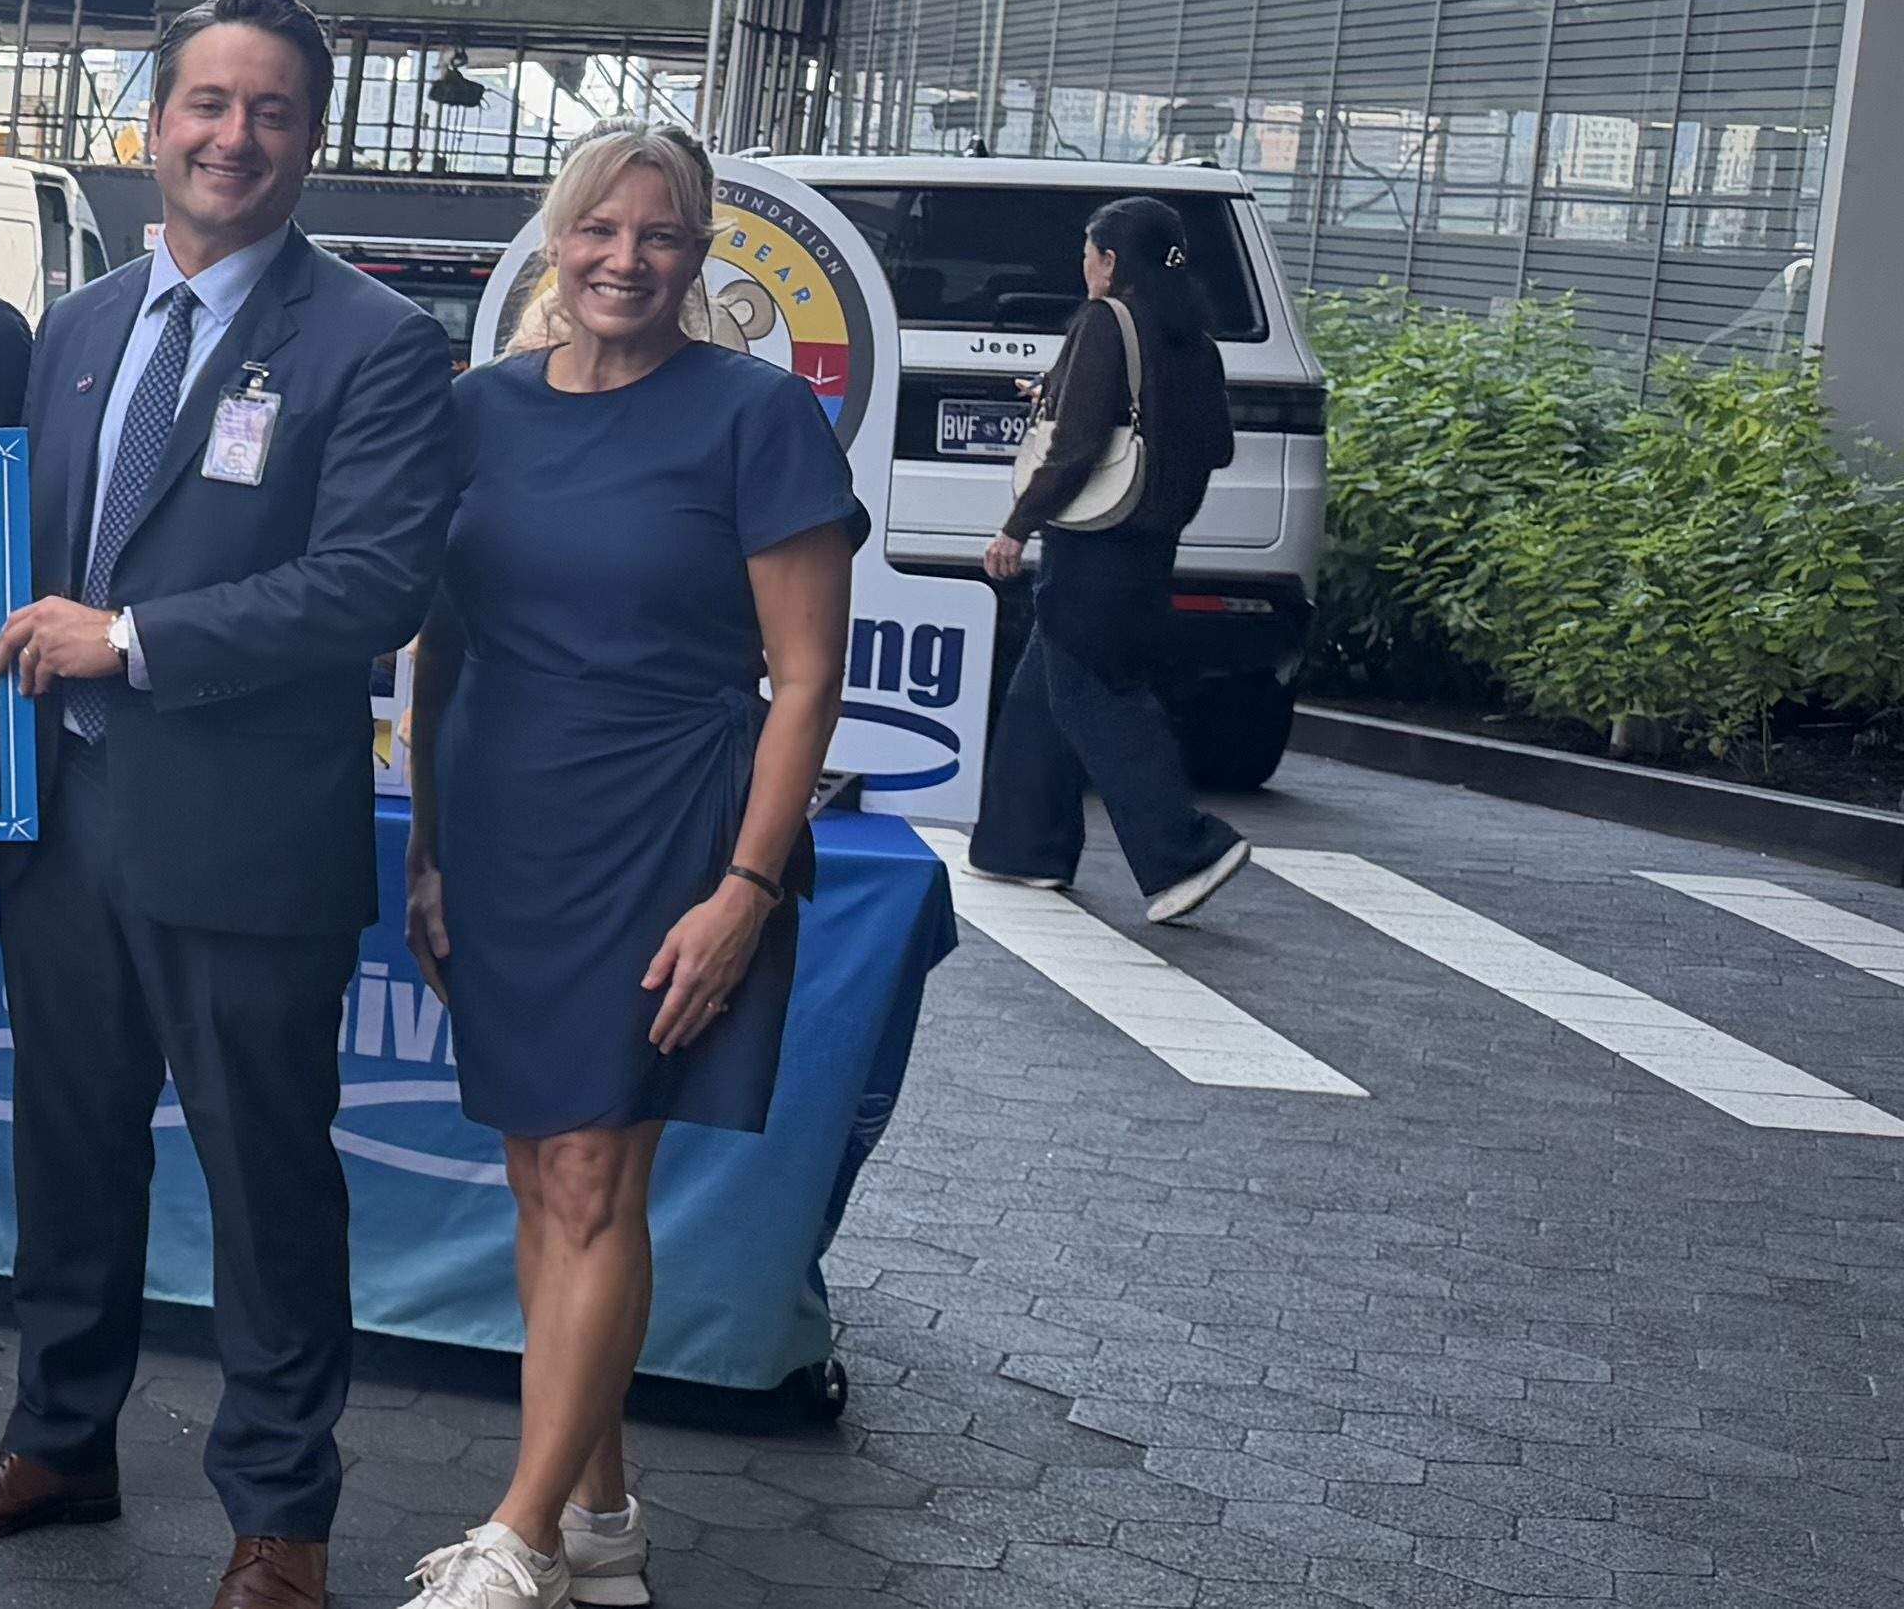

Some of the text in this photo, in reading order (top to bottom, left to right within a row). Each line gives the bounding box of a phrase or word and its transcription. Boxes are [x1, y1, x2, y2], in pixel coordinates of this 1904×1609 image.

[716, 186, 842, 275] OUNDATION
[730, 229, 812, 305] BEAR
[970, 338, 1036, 357] Jeep
[944, 415, 1025, 443] BVF 99
